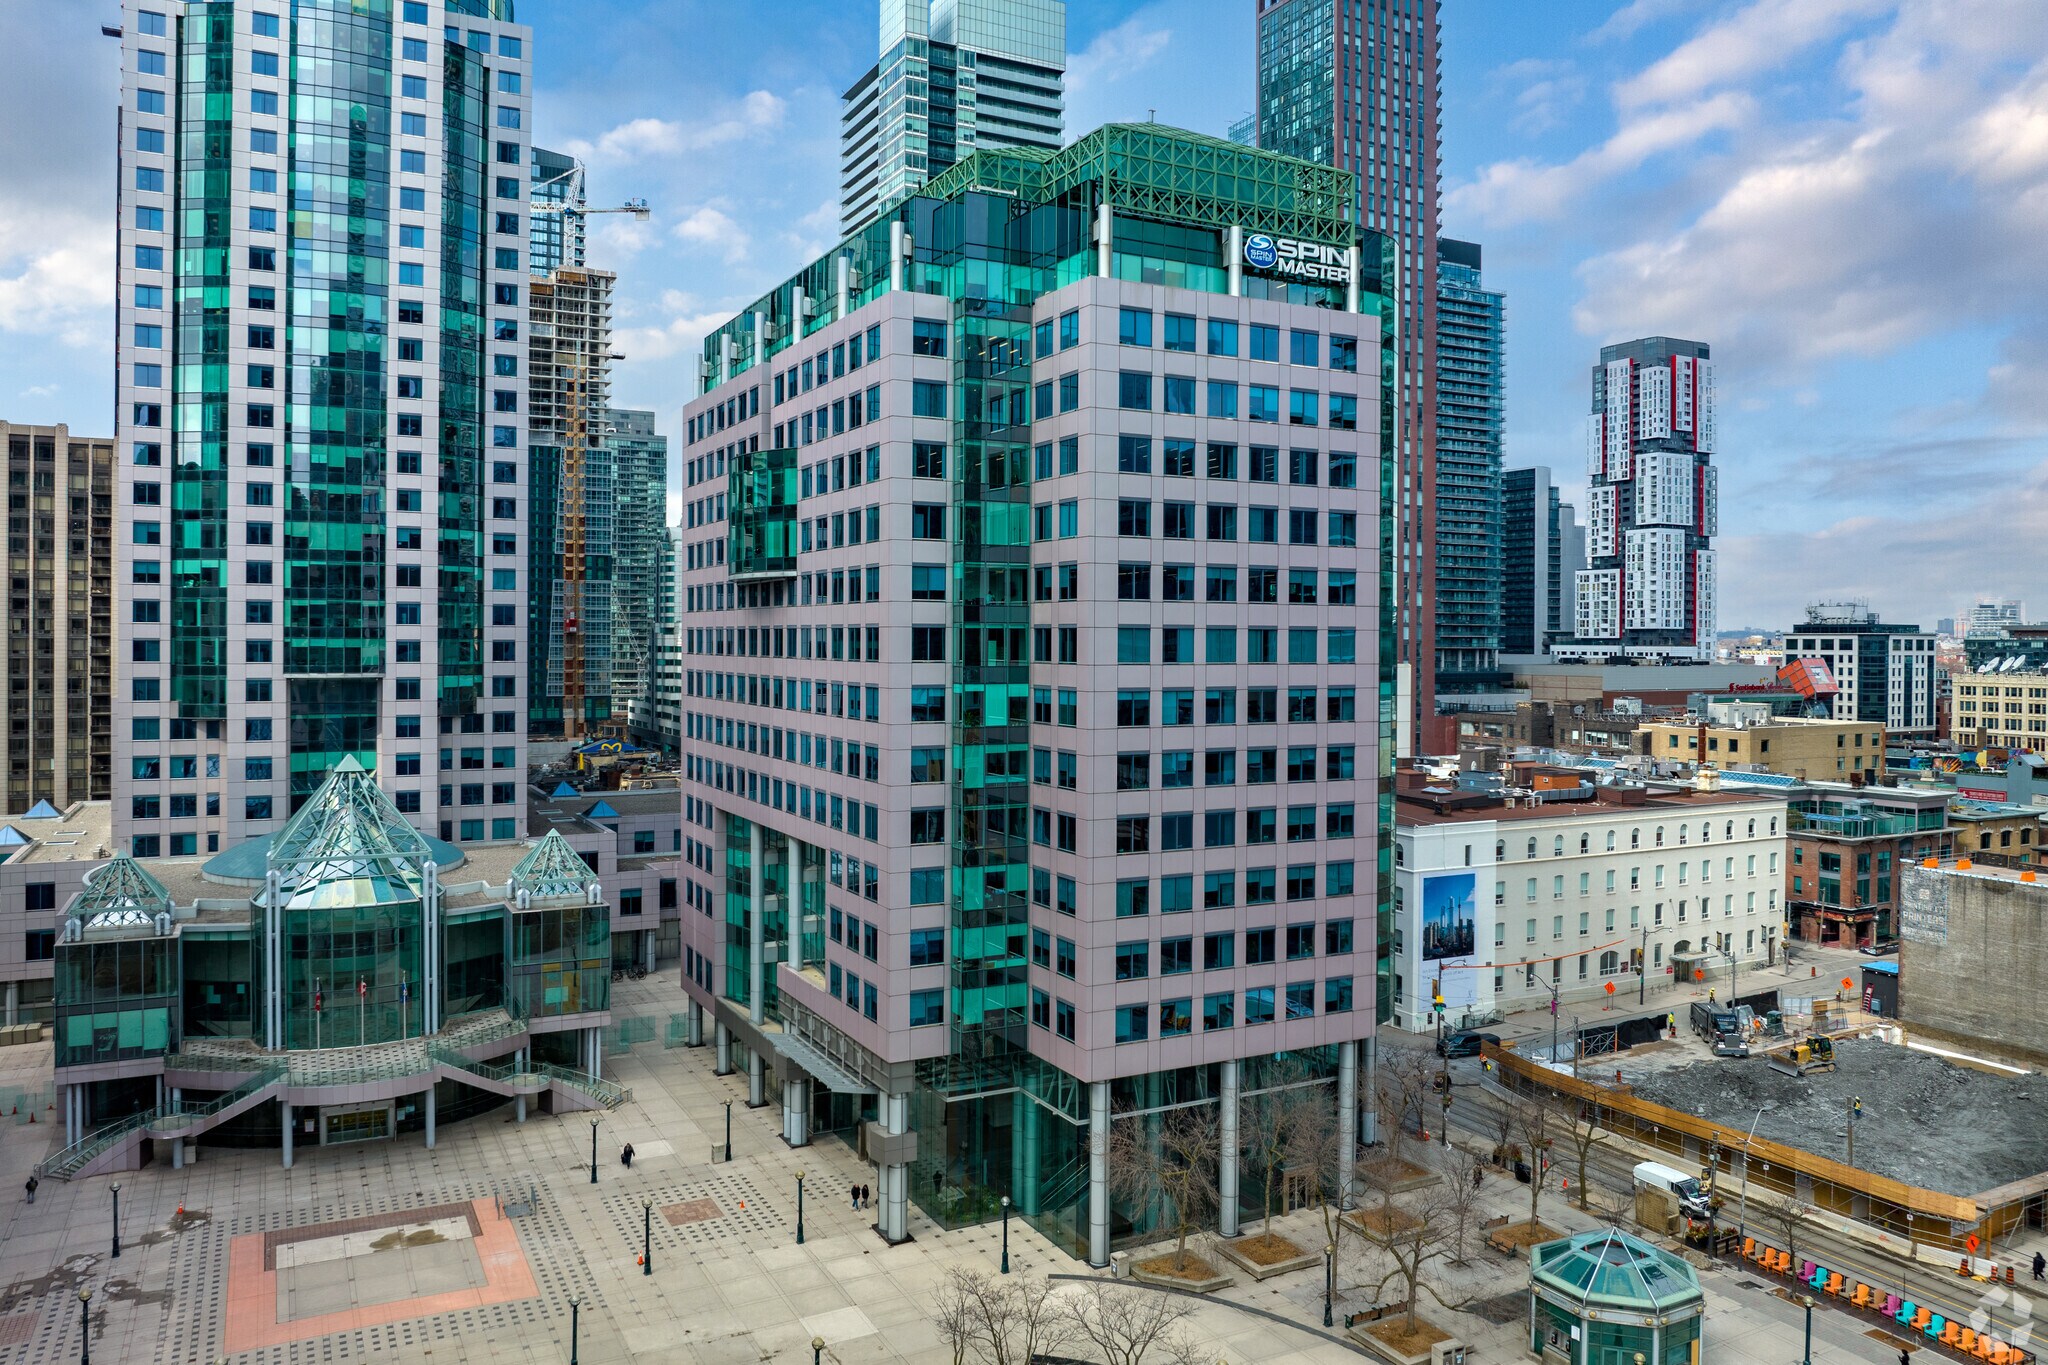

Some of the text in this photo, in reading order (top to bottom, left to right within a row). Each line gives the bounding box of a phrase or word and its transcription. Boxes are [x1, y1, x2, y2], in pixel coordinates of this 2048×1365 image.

[1250, 249, 1273, 258] SPIN
[1277, 238, 1350, 267] SPIN
[1278, 257, 1350, 283] MASTER
